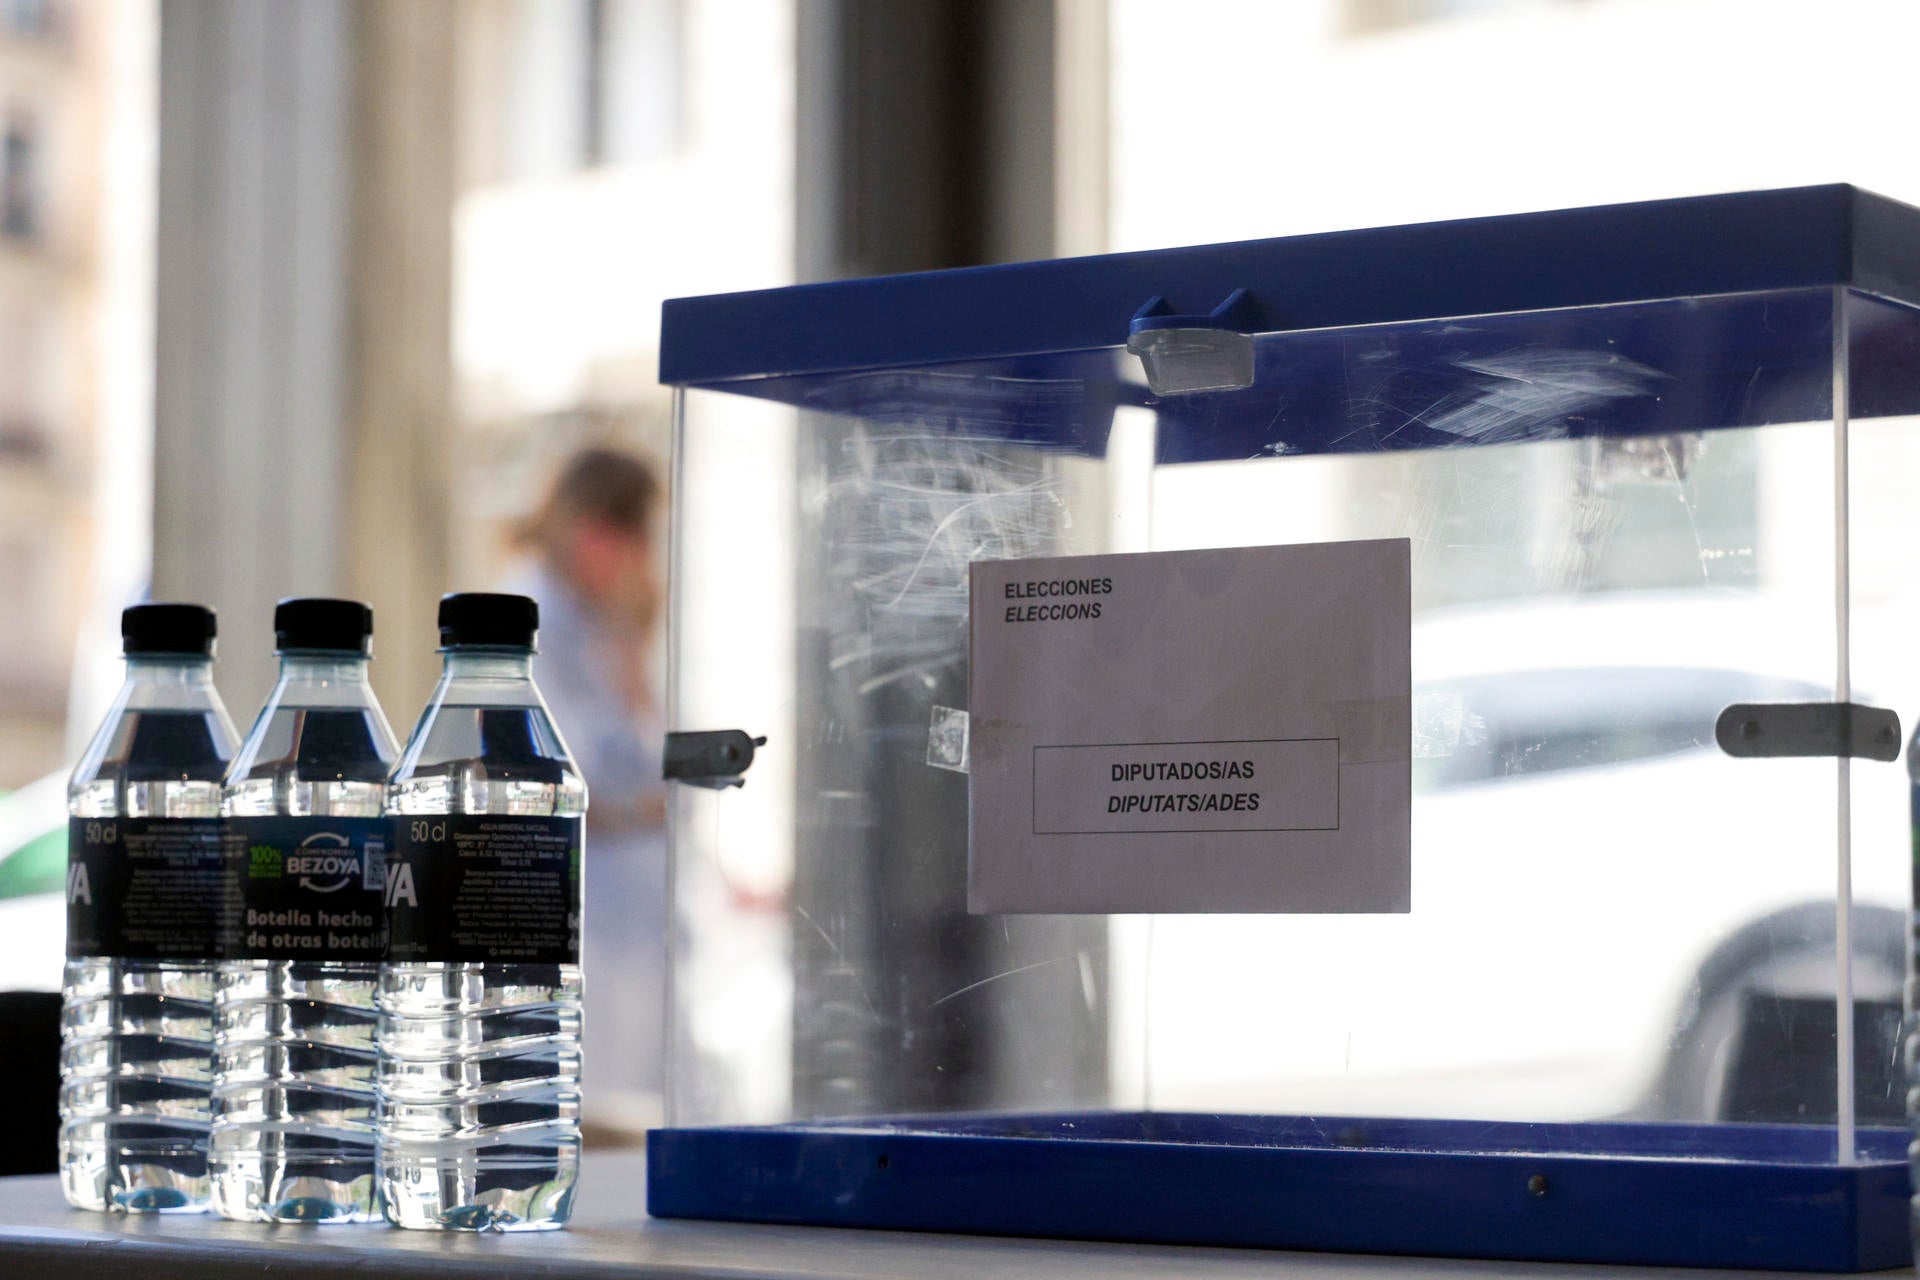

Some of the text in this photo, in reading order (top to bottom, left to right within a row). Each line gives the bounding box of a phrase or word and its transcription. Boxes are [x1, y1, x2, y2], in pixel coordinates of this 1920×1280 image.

[1004, 578, 1113, 599] ELECCIONES
[1004, 602, 1103, 623] ELECCIONS
[1111, 760, 1255, 782] DIPUTADOS/AS
[1107, 793, 1260, 814] DIPUTATS/ADES
[86, 822, 101, 844] 50
[103, 822, 118, 845] cl
[411, 820, 446, 843] 50 cl
[249, 845, 282, 864] 100%
[287, 857, 361, 875] BEZOYA
[246, 908, 374, 927] Botella hecha
[246, 929, 267, 948] de
[271, 930, 322, 949] otras
[328, 931, 386, 950] botell
